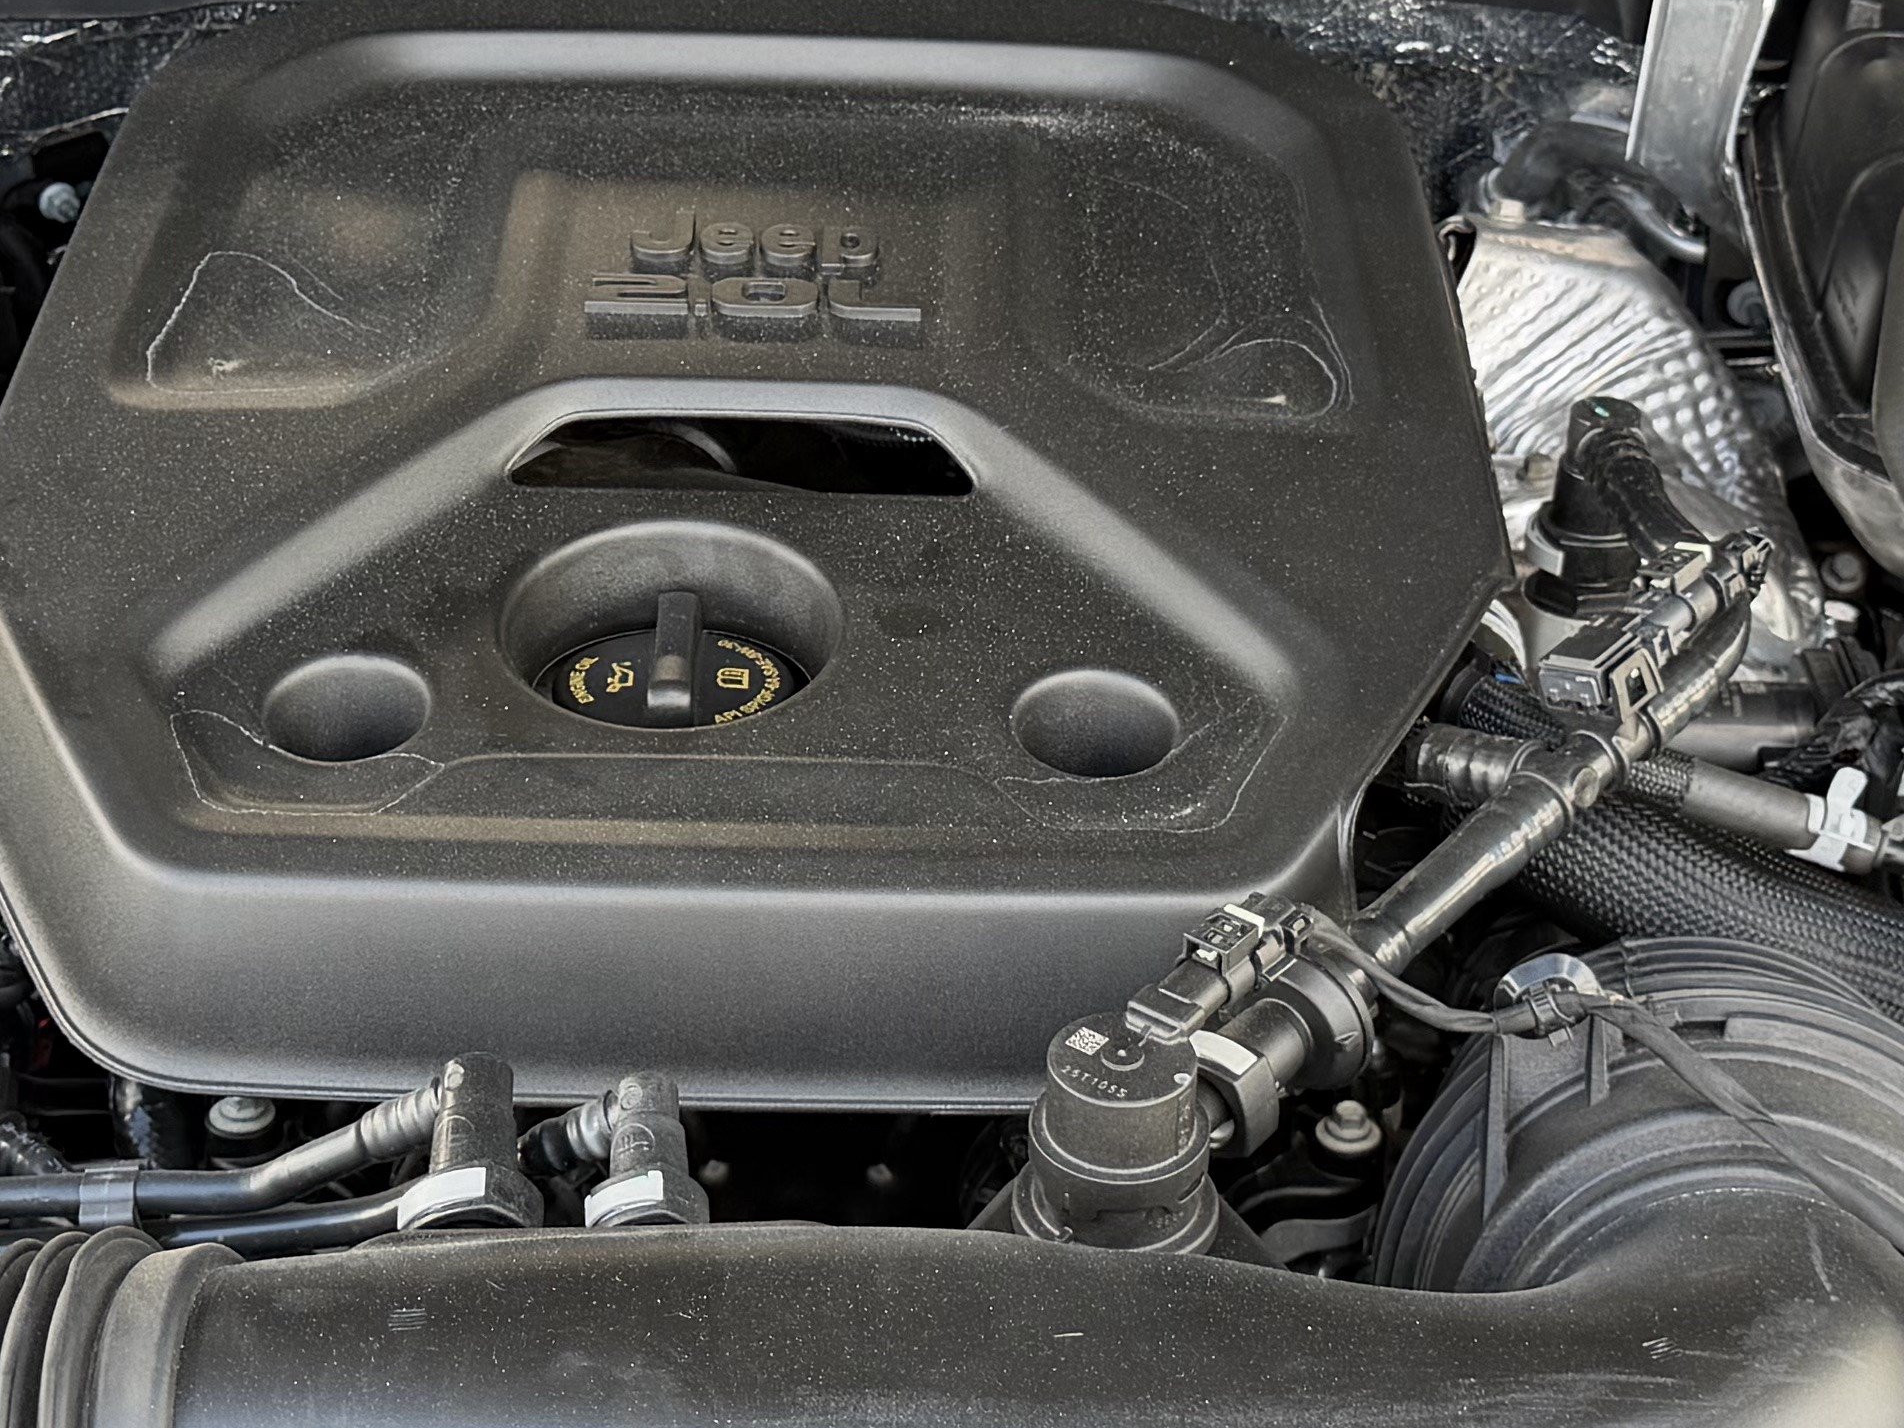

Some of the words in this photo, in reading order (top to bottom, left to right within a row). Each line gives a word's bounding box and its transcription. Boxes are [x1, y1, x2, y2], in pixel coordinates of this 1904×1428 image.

[629, 209, 881, 276] Jeep
[583, 271, 922, 324] 2.0L
[575, 656, 599, 670] OIL
[568, 670, 594, 703] ENGINE
